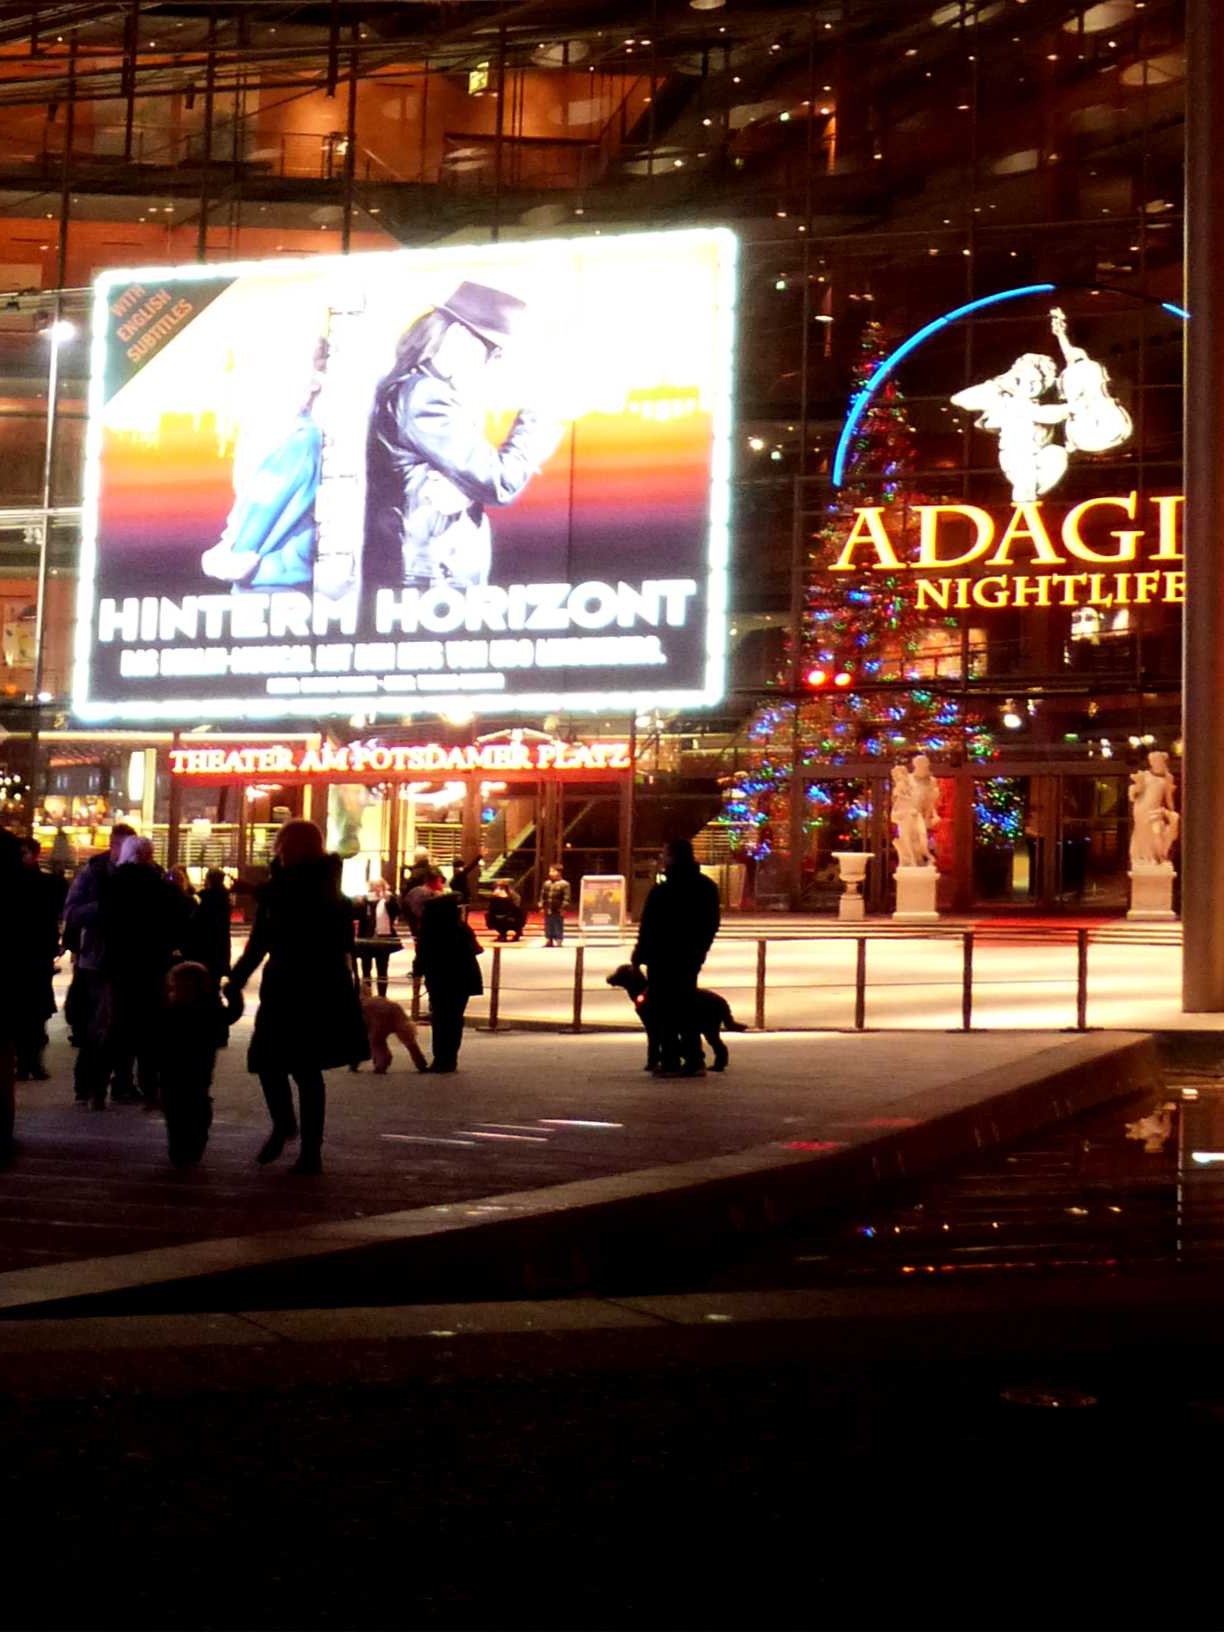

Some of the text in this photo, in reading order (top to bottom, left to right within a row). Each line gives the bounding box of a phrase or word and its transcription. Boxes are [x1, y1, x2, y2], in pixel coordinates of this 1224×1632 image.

[110, 282, 146, 317] WITH
[116, 288, 172, 342] ENGLISH
[127, 298, 193, 363] SUBTITLES
[98, 578, 697, 643] HINTERM HORIZONT
[915, 570, 1186, 609] NIGHTLIFE
[169, 743, 631, 774] THEATER AM POTSDAMER PLATZ
